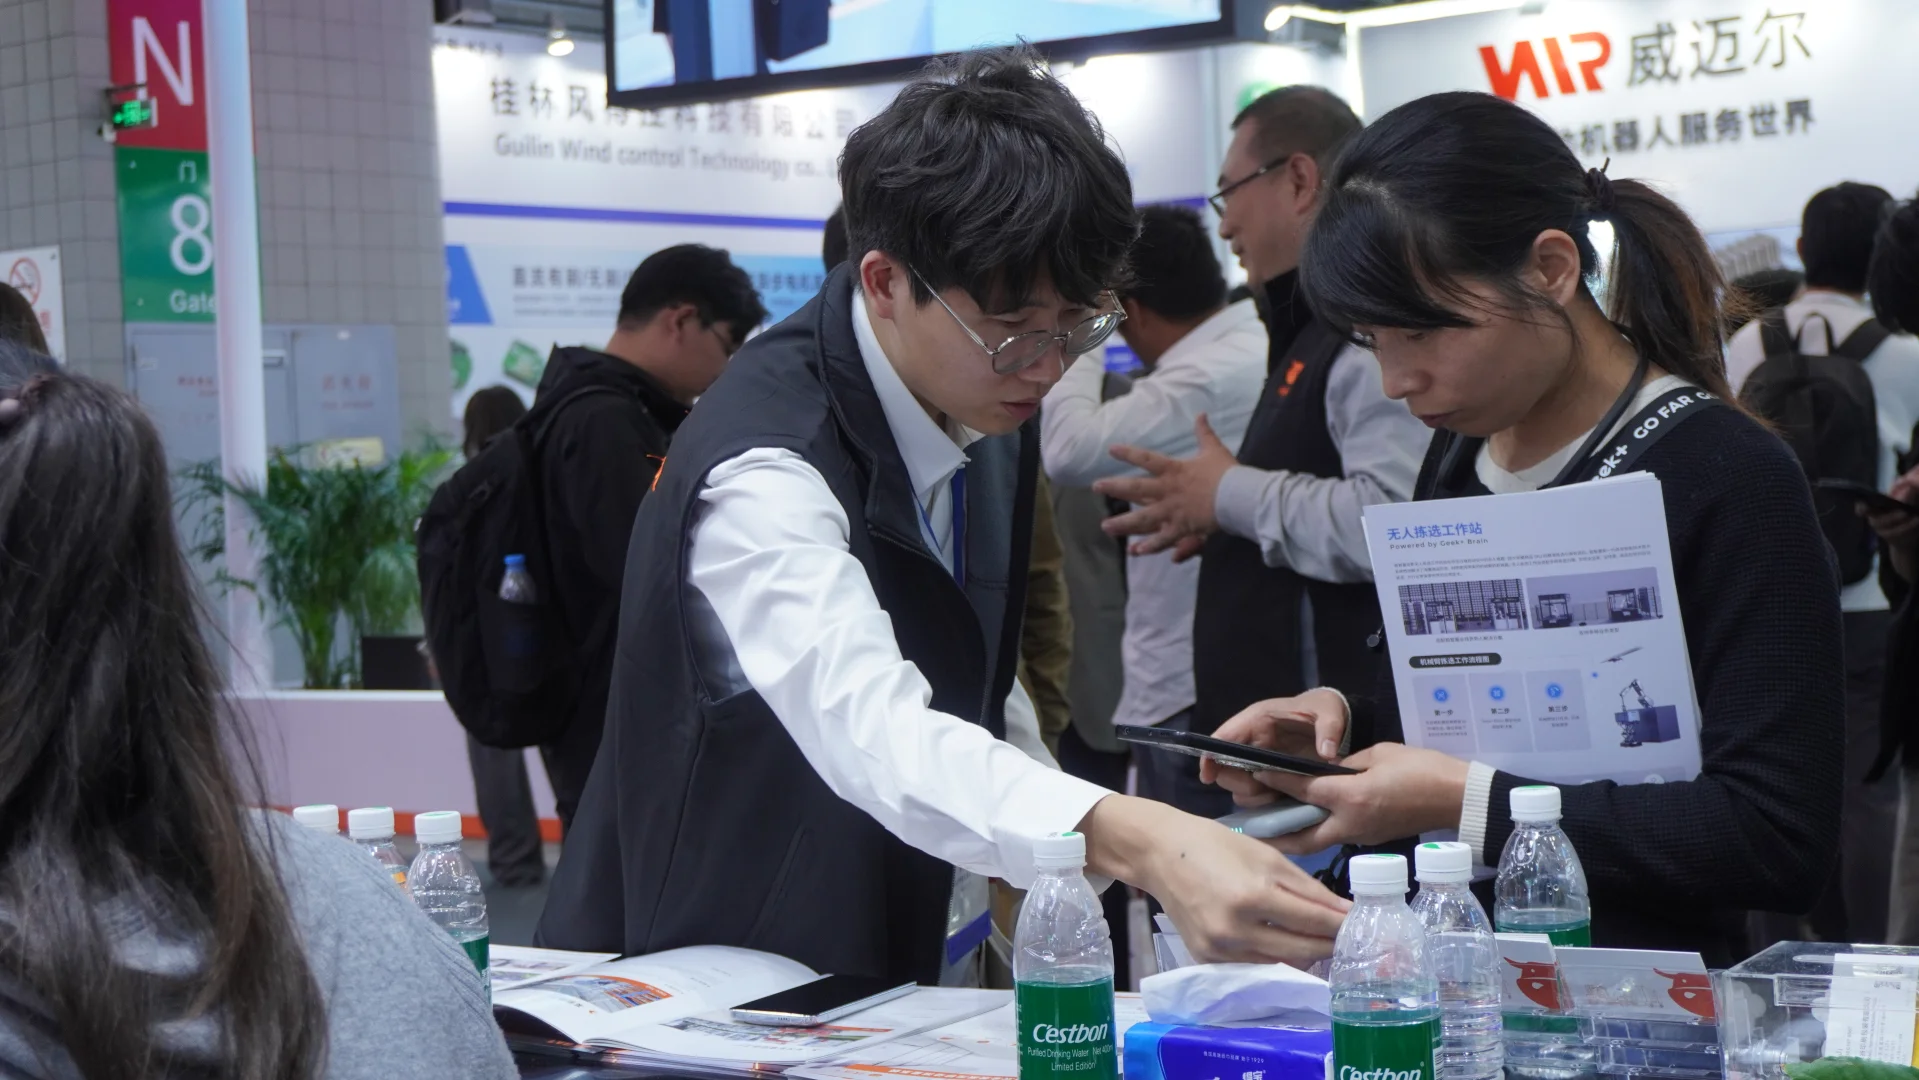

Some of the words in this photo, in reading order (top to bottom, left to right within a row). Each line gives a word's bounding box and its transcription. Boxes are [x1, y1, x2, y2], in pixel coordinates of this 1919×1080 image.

[1627, 8, 1811, 87] 威迈尔
[132, 16, 193, 106] N
[495, 133, 554, 159] Guilin
[559, 136, 612, 165] Wind
[617, 141, 685, 170] control
[688, 146, 790, 182] Technology
[170, 193, 215, 276] 8
[1632, 416, 1660, 440] GO
[1657, 395, 1695, 419] FAR
[1387, 521, 1483, 541] 无人拣选工作站
[1390, 542, 1425, 550] Powered
[1428, 541, 1438, 549] by
[1440, 539, 1464, 547] Geek+
[1467, 537, 1489, 545] Brain
[1491, 707, 1510, 715] 第二步
[1548, 705, 1568, 713] 第三步
[1027, 1046, 1047, 1058] Purified
[1047, 1048, 1071, 1060] Drinking
[1072, 1048, 1089, 1058] Water
[1051, 1062, 1074, 1071] Limited
[1075, 1060, 1096, 1071] Edition
